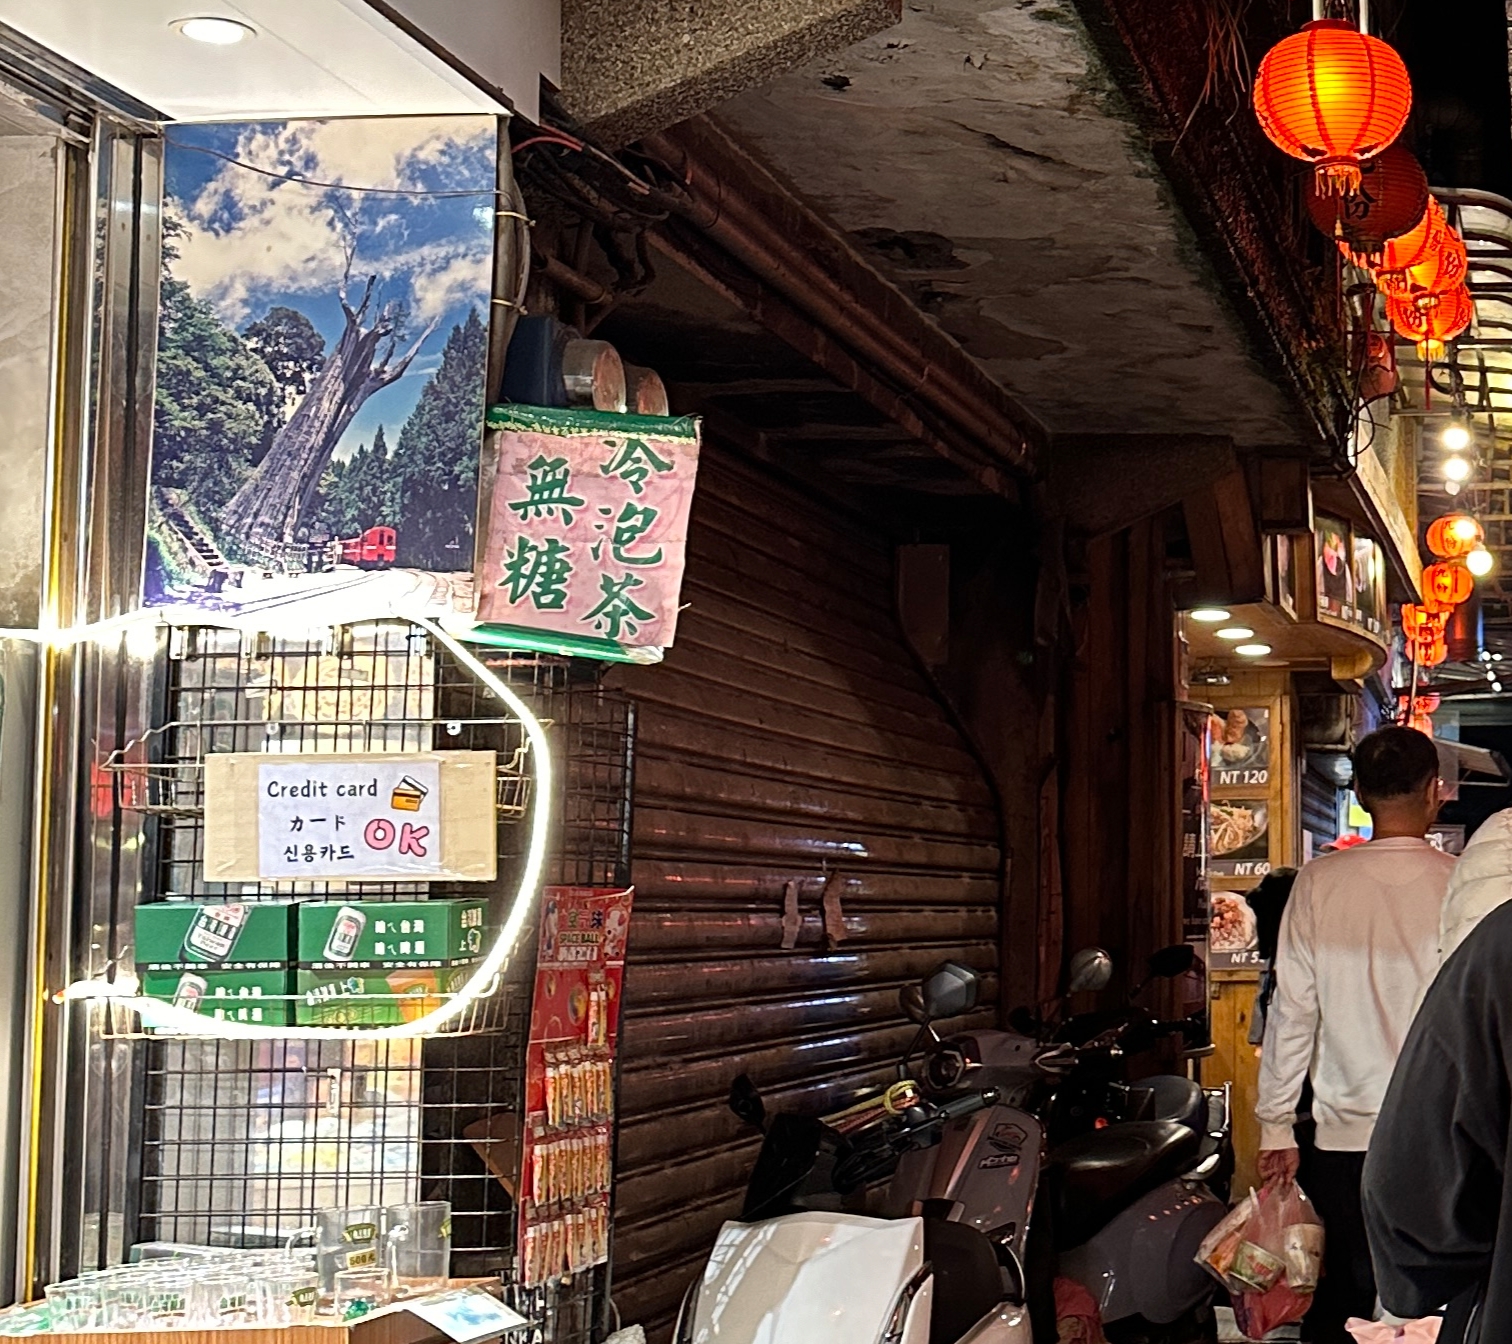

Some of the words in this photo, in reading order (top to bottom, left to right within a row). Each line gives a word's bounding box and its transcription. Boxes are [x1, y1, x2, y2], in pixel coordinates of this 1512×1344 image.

[498, 454, 585, 610] 無糖
[580, 438, 675, 640] 冷泡茶
[1220, 770, 1239, 785] NT
[1243, 769, 1268, 784] 120
[267, 780, 328, 798] Credit
[336, 779, 378, 797] card
[290, 814, 346, 832] カード
[363, 818, 430, 858] OK
[283, 842, 355, 863] 신용카드
[1235, 862, 1252, 876] NT
[1254, 862, 1271, 876] 60
[580, 933, 600, 945] BALL
[1230, 951, 1248, 964] NT
[1250, 951, 1266, 964] 5
